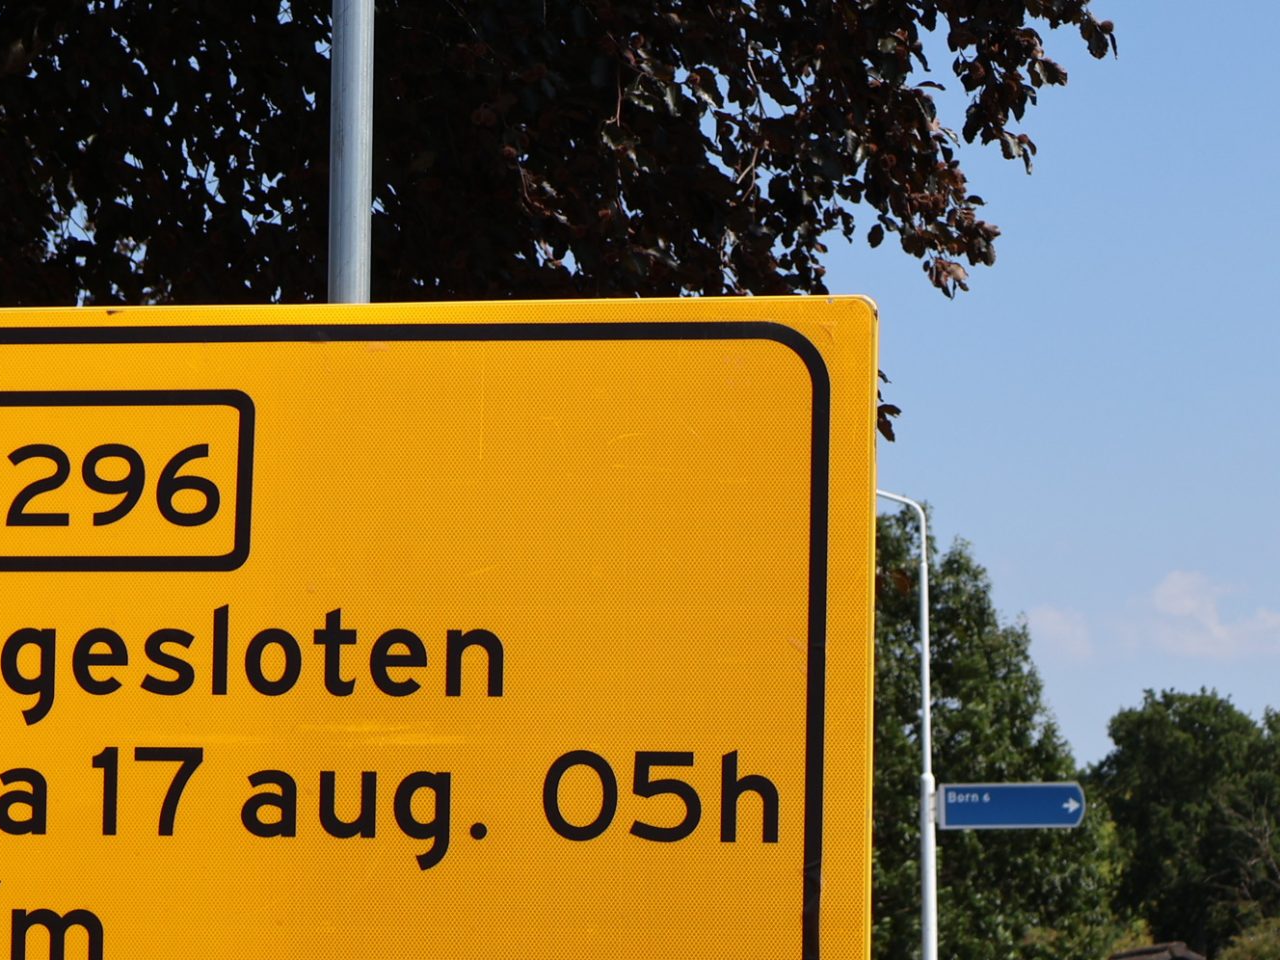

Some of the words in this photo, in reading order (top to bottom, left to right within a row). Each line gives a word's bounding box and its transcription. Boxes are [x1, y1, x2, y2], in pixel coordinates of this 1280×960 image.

[92, 746, 205, 837] 17
[239, 769, 489, 871] aug.
[542, 749, 781, 844] 05h
[947, 791, 979, 803] Born
